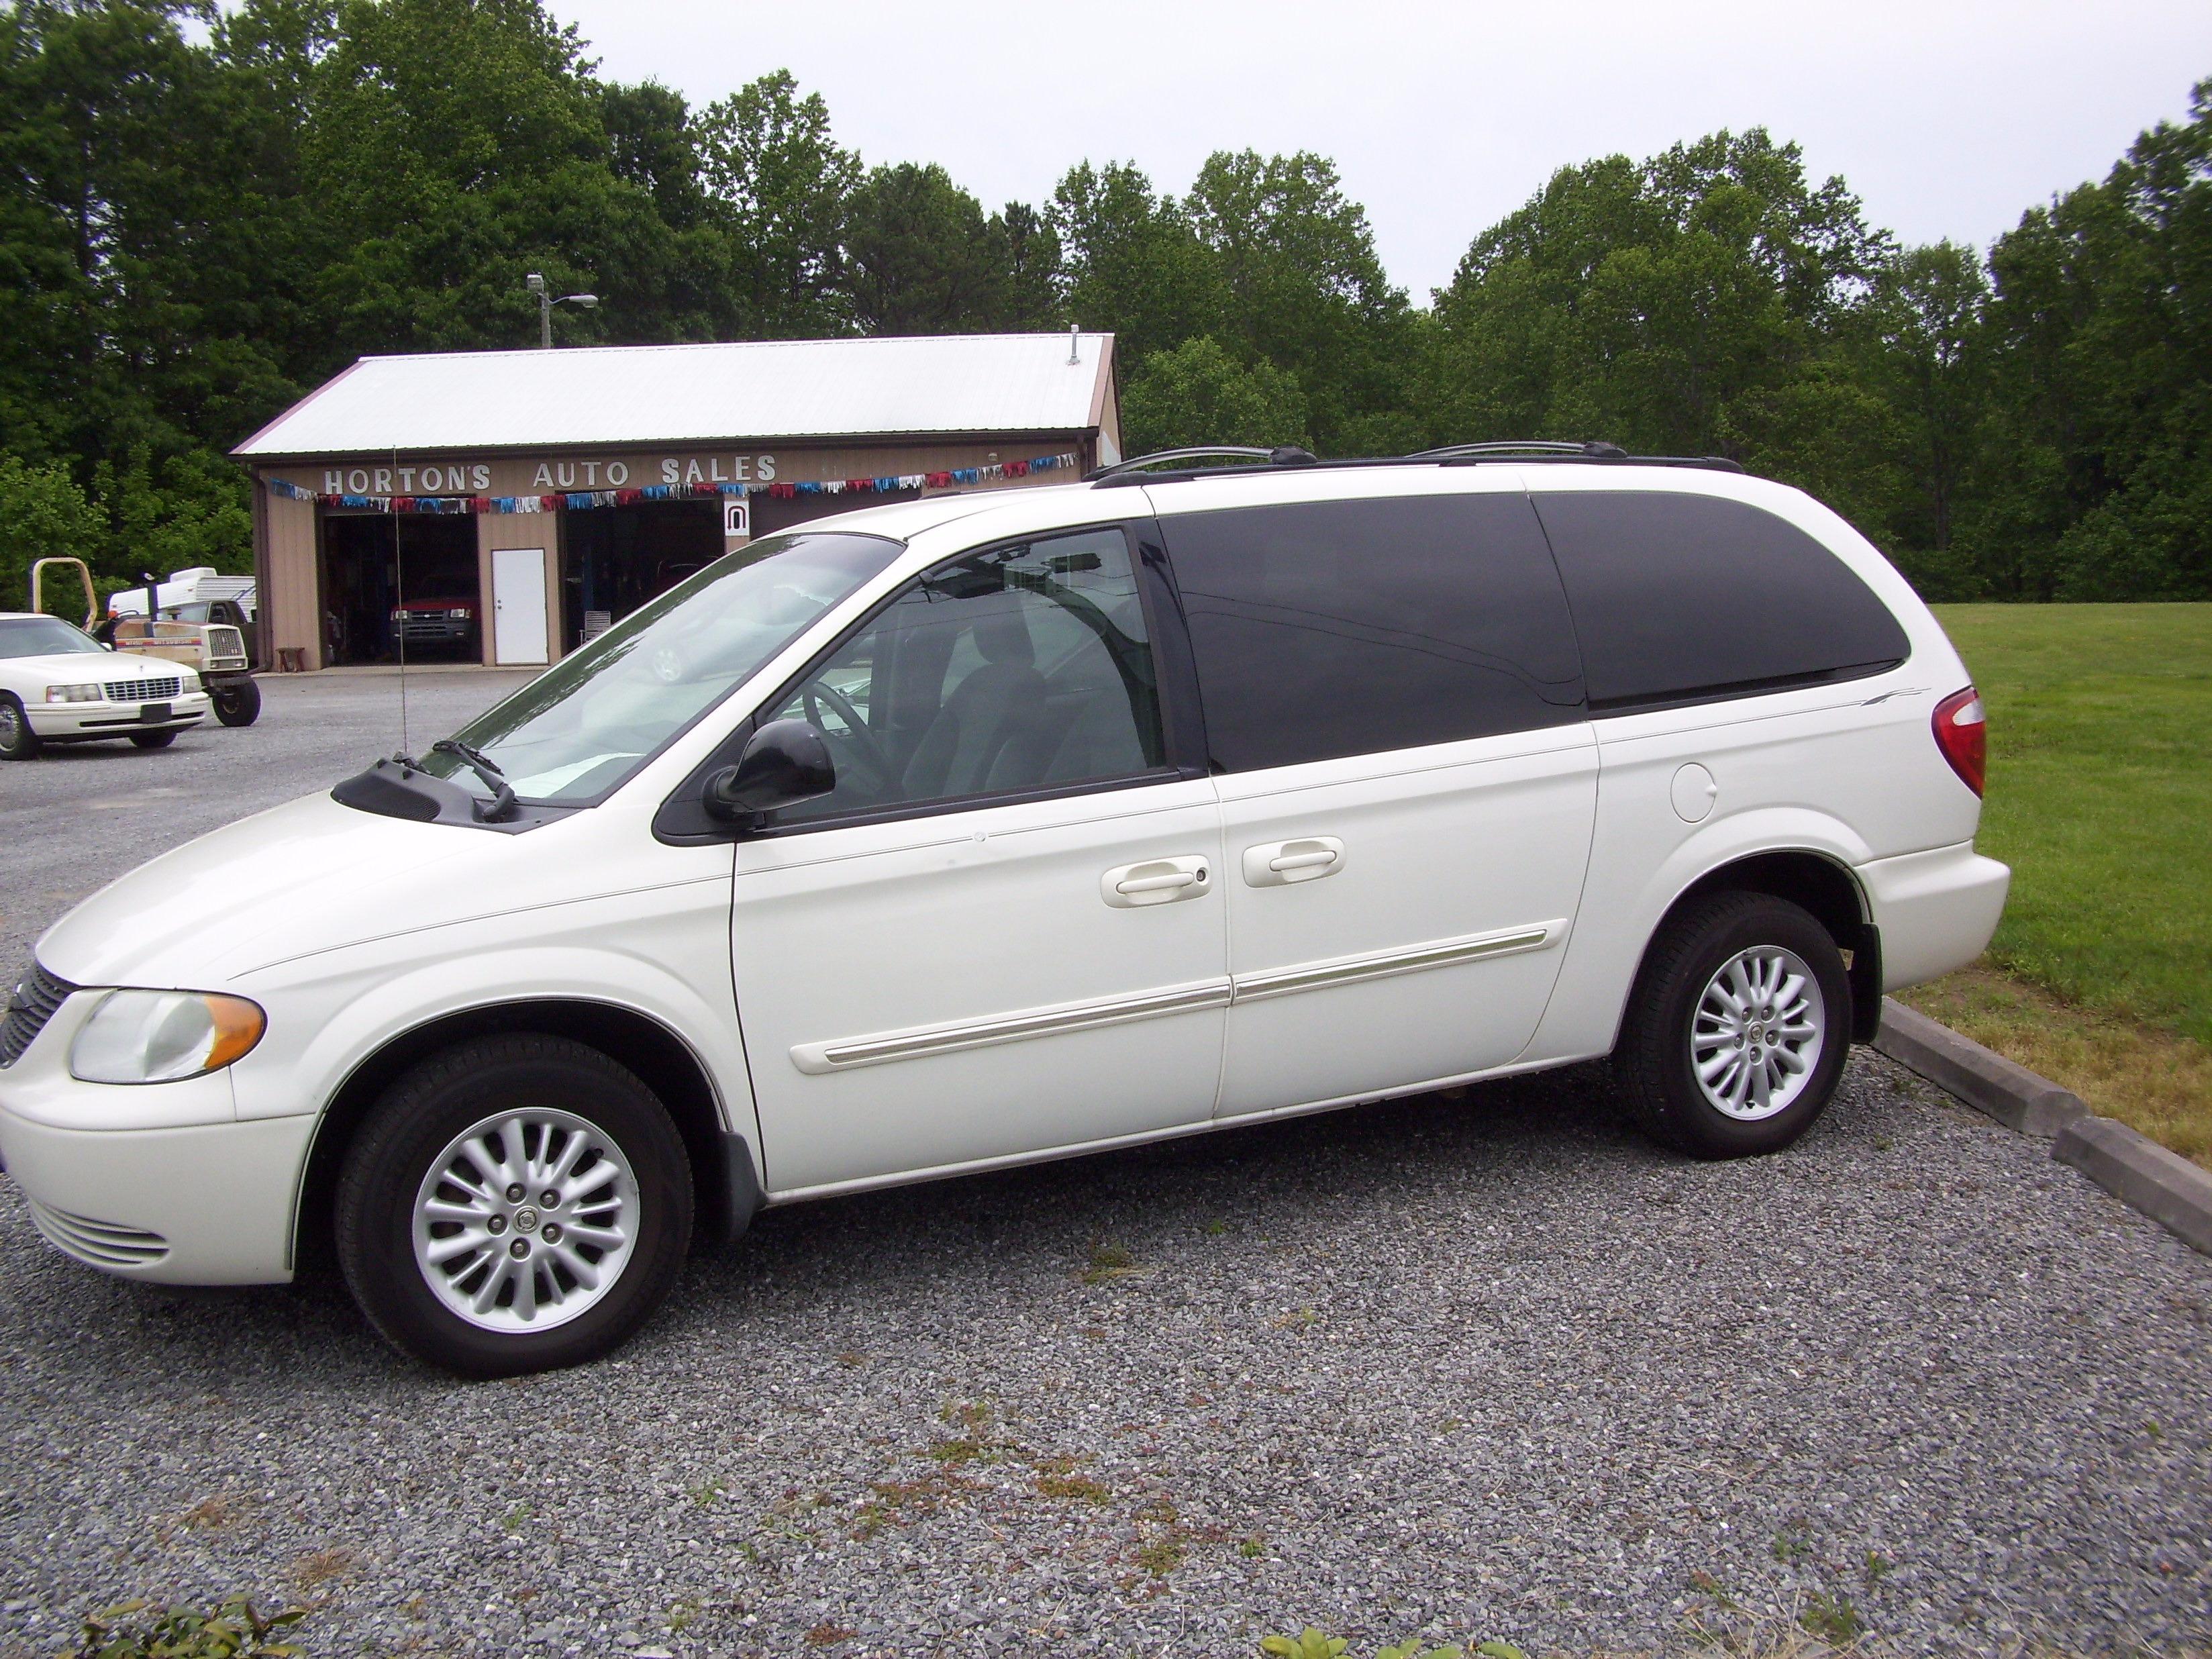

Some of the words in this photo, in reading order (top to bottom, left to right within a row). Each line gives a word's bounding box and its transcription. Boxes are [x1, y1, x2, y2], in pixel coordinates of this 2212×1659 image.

[325, 464, 491, 495] HORTON'S
[533, 461, 629, 487] AUTO
[661, 455, 776, 484] SALES
